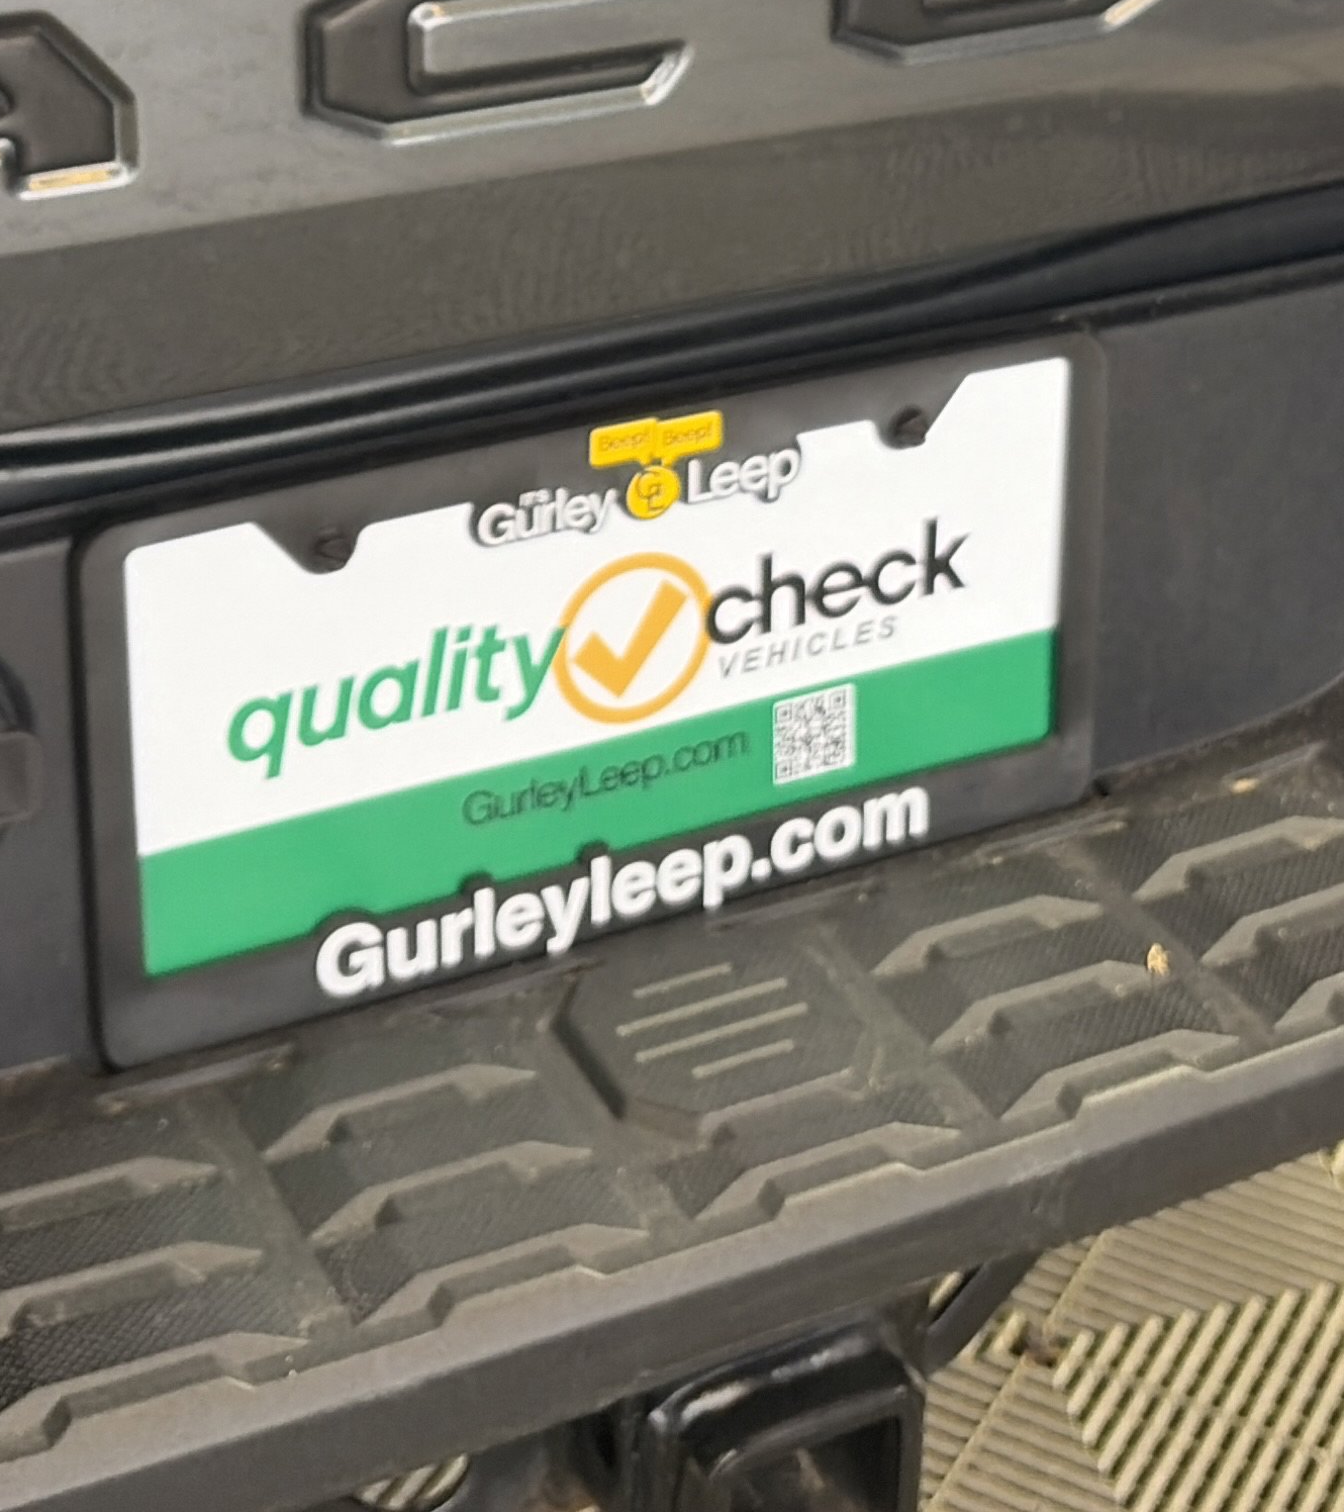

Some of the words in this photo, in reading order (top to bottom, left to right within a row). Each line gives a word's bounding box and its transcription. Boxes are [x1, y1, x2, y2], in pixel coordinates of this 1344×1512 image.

[598, 426, 652, 453] Beep!
[662, 420, 714, 447] Beep!
[477, 487, 617, 546] Gurley
[687, 448, 801, 502] Leep
[227, 620, 569, 780] quality
[705, 516, 972, 645] check
[717, 614, 900, 680] VEHICLES
[462, 727, 751, 828] GurleyLeep.com
[315, 785, 931, 999] Gurleyleep.com
